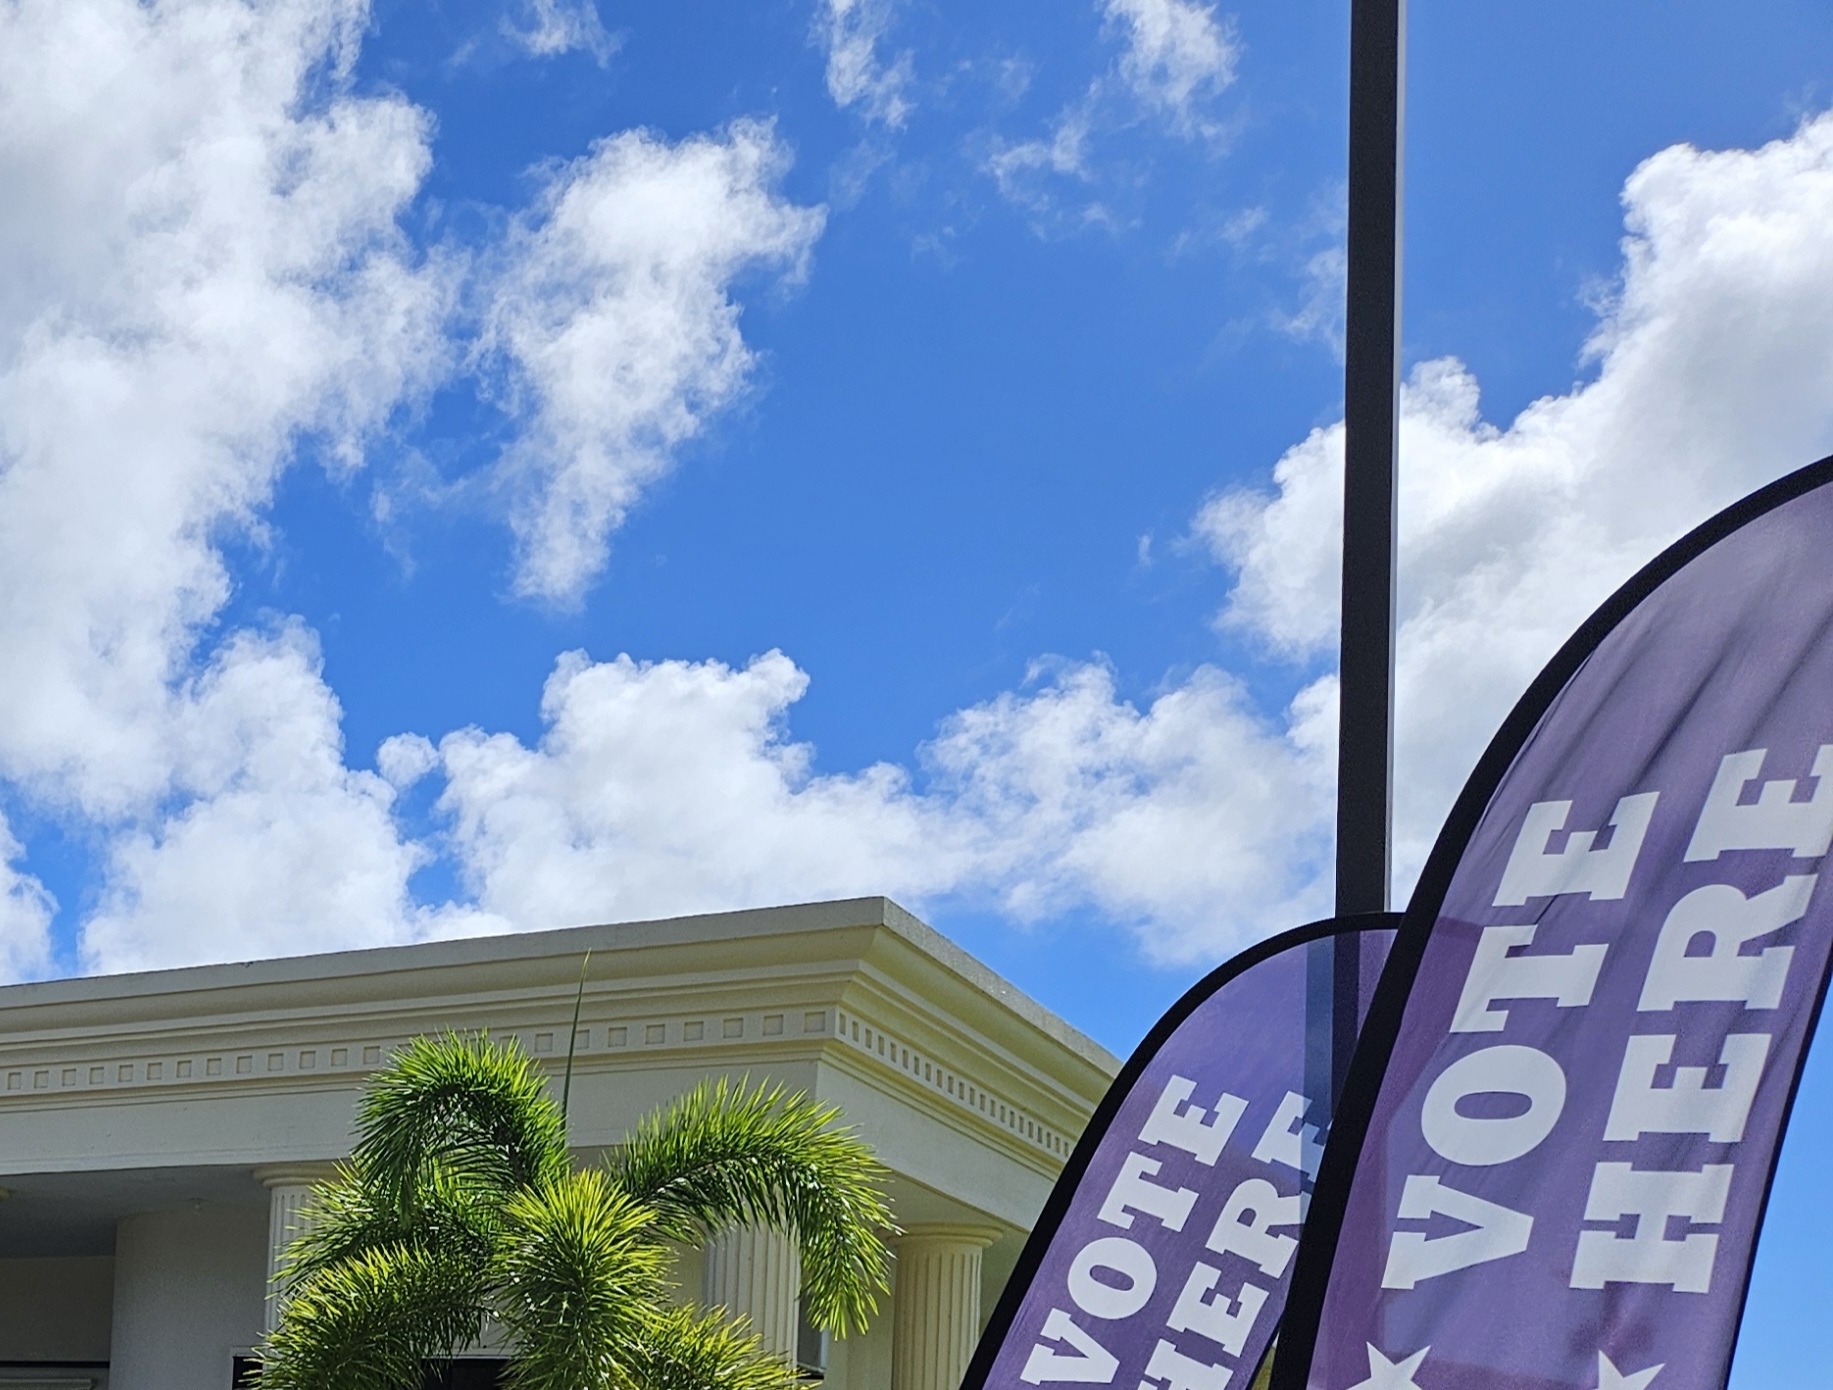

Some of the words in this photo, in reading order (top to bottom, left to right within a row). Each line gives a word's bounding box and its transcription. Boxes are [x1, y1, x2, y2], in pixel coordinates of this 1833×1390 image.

[1019, 1074, 1249, 1386] VOTE
[1381, 790, 1660, 1290] VOTE
[1569, 744, 1833, 1293] HERE
